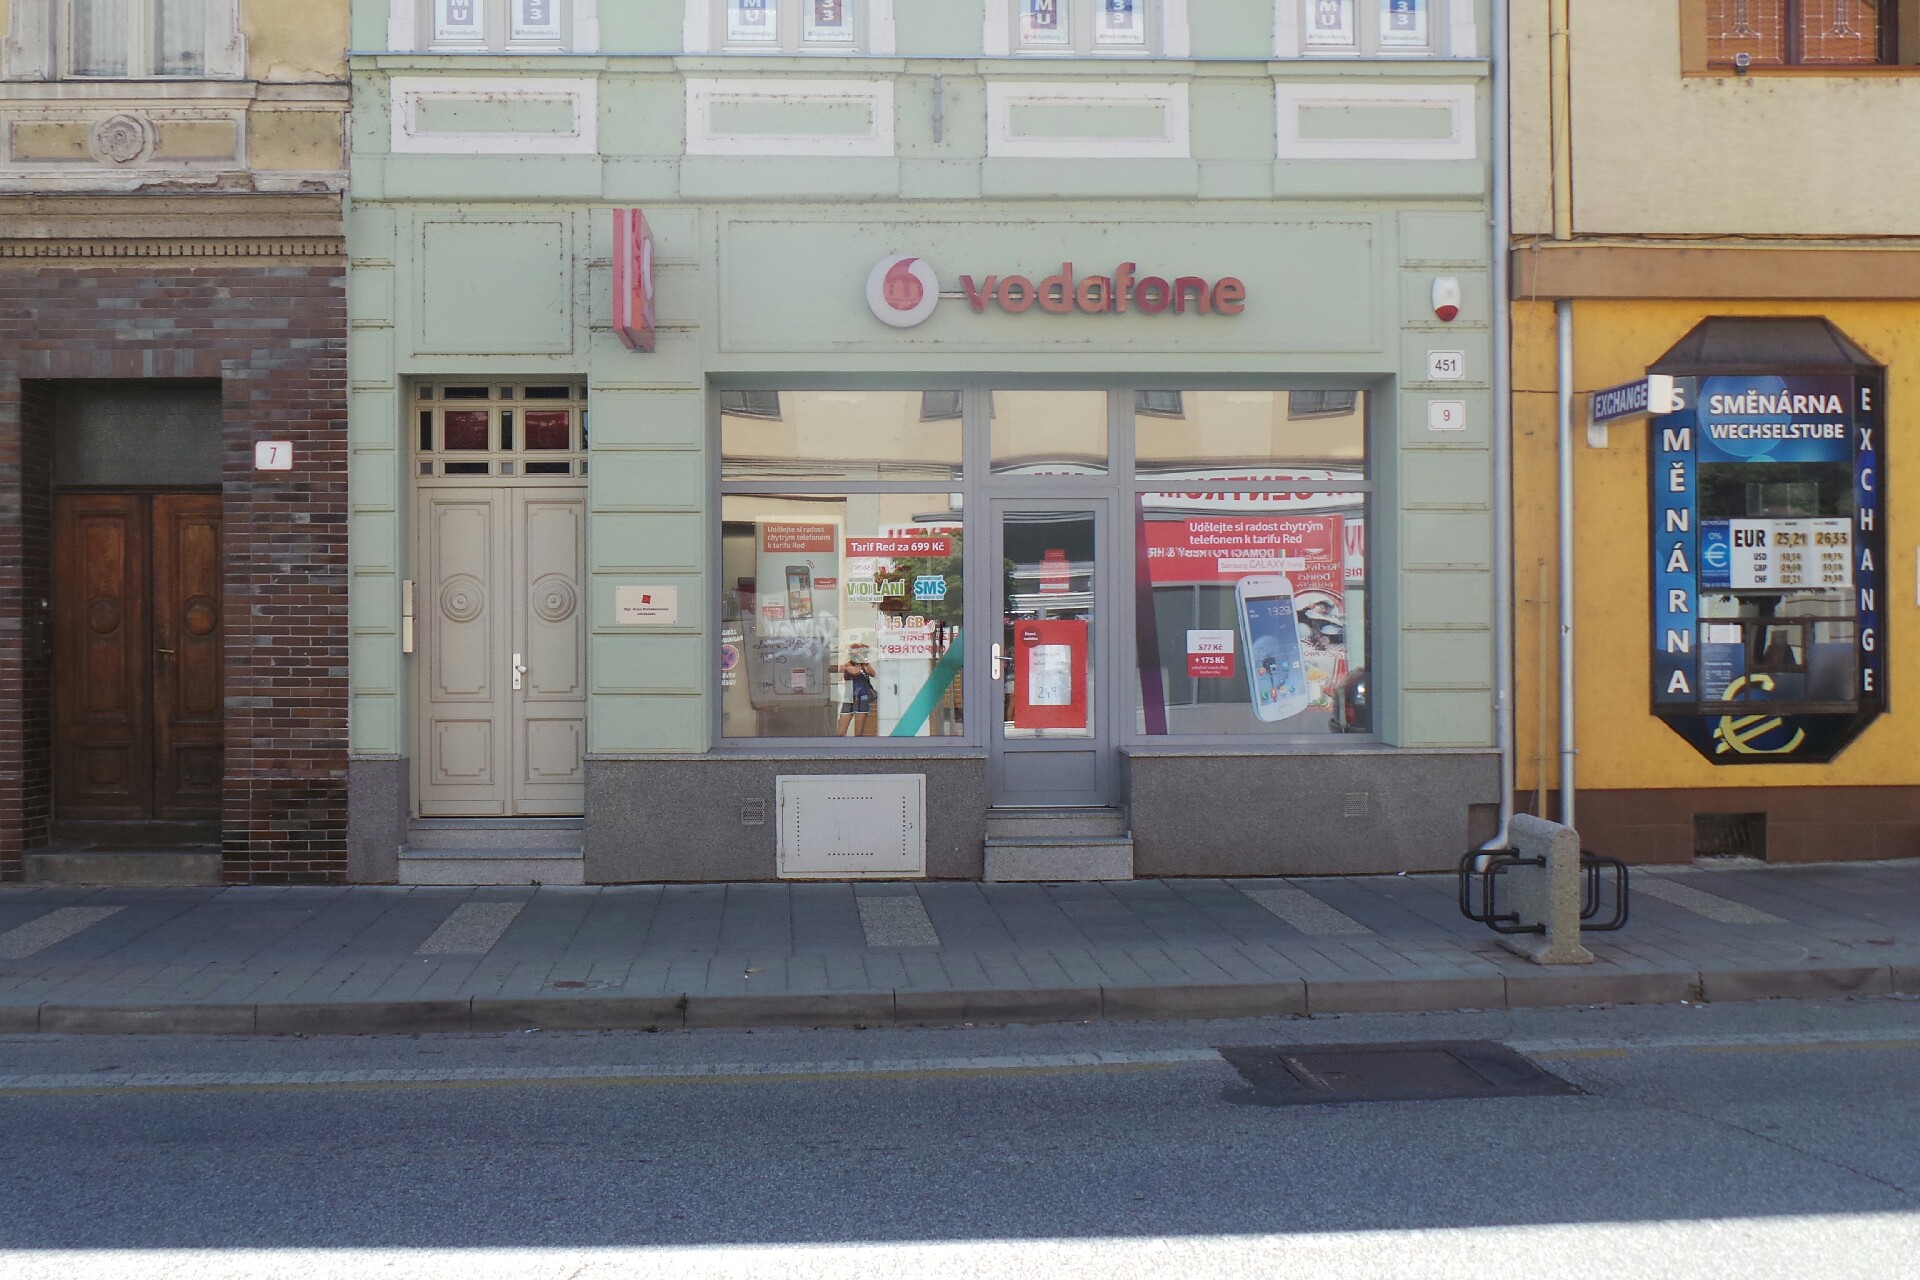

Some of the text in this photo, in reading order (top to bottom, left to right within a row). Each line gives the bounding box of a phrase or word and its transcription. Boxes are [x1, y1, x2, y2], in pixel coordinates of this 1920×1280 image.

[959, 262, 1246, 314] vodafone
[1434, 360, 1456, 372] 451
[1595, 383, 1648, 418] EXCHANGE
[1710, 390, 1843, 414] SMĚNÁRNA
[1443, 409, 1450, 422] 9
[1710, 424, 1844, 438] WECHSELSTUBE
[270, 446, 277, 464] 7
[767, 526, 796, 534] Udělejte
[1189, 521, 1324, 534] Udělejte si radost chytrým
[768, 534, 796, 542] chytrým
[1190, 534, 1302, 544] telefonem k tarifu Red
[1662, 387, 1690, 693] SMĚNÁRNA
[1734, 530, 1766, 548] EUR
[1860, 387, 1875, 692] EXCHANGE
[850, 542, 944, 552] Tarif Red za 699 Kč
[1221, 562, 1248, 570] Samsung
[1250, 560, 1285, 569] GALAXY
[1754, 564, 1767, 572] GBP
[847, 579, 905, 596] VOLÁNÍ
[914, 581, 946, 595] SMS
[885, 616, 925, 630] 1,5 GB
[1200, 656, 1214, 664] 175
[1215, 656, 1225, 664] Kč
